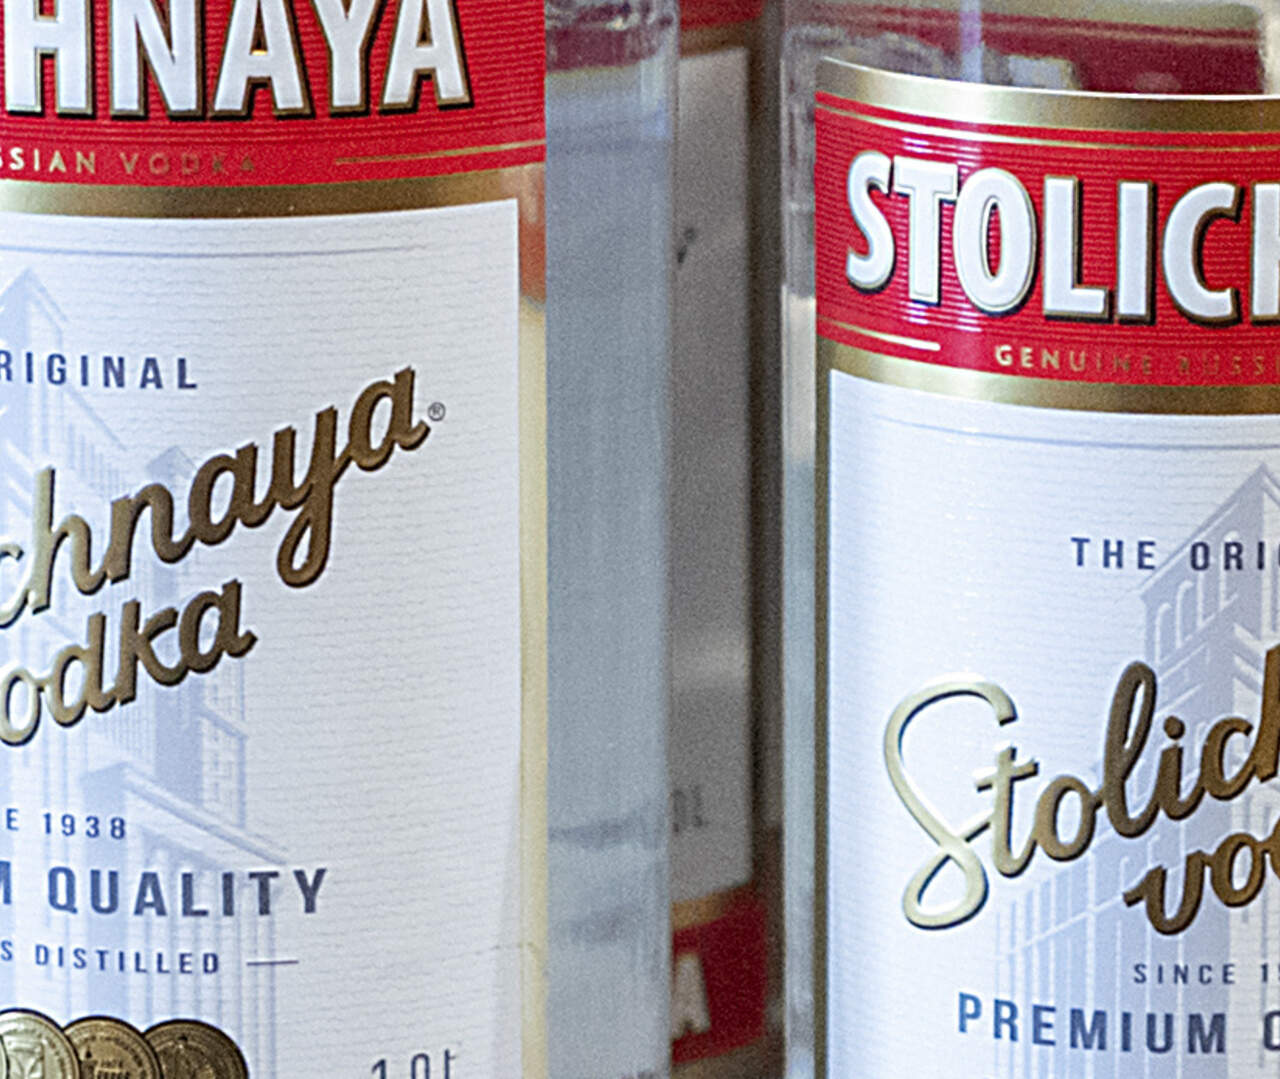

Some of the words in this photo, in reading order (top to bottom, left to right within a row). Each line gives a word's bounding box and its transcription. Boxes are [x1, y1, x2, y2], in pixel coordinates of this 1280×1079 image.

[120, 150, 257, 176] VODKA
[994, 344, 1154, 375] GENUINE
[1070, 536, 1157, 572] THE
[41, 811, 129, 841] 1938
[46, 866, 331, 918] QUALITY
[35, 944, 221, 976] DISTILLED
[1132, 960, 1237, 986] SINCE
[957, 991, 1229, 1056] PREMIUM
